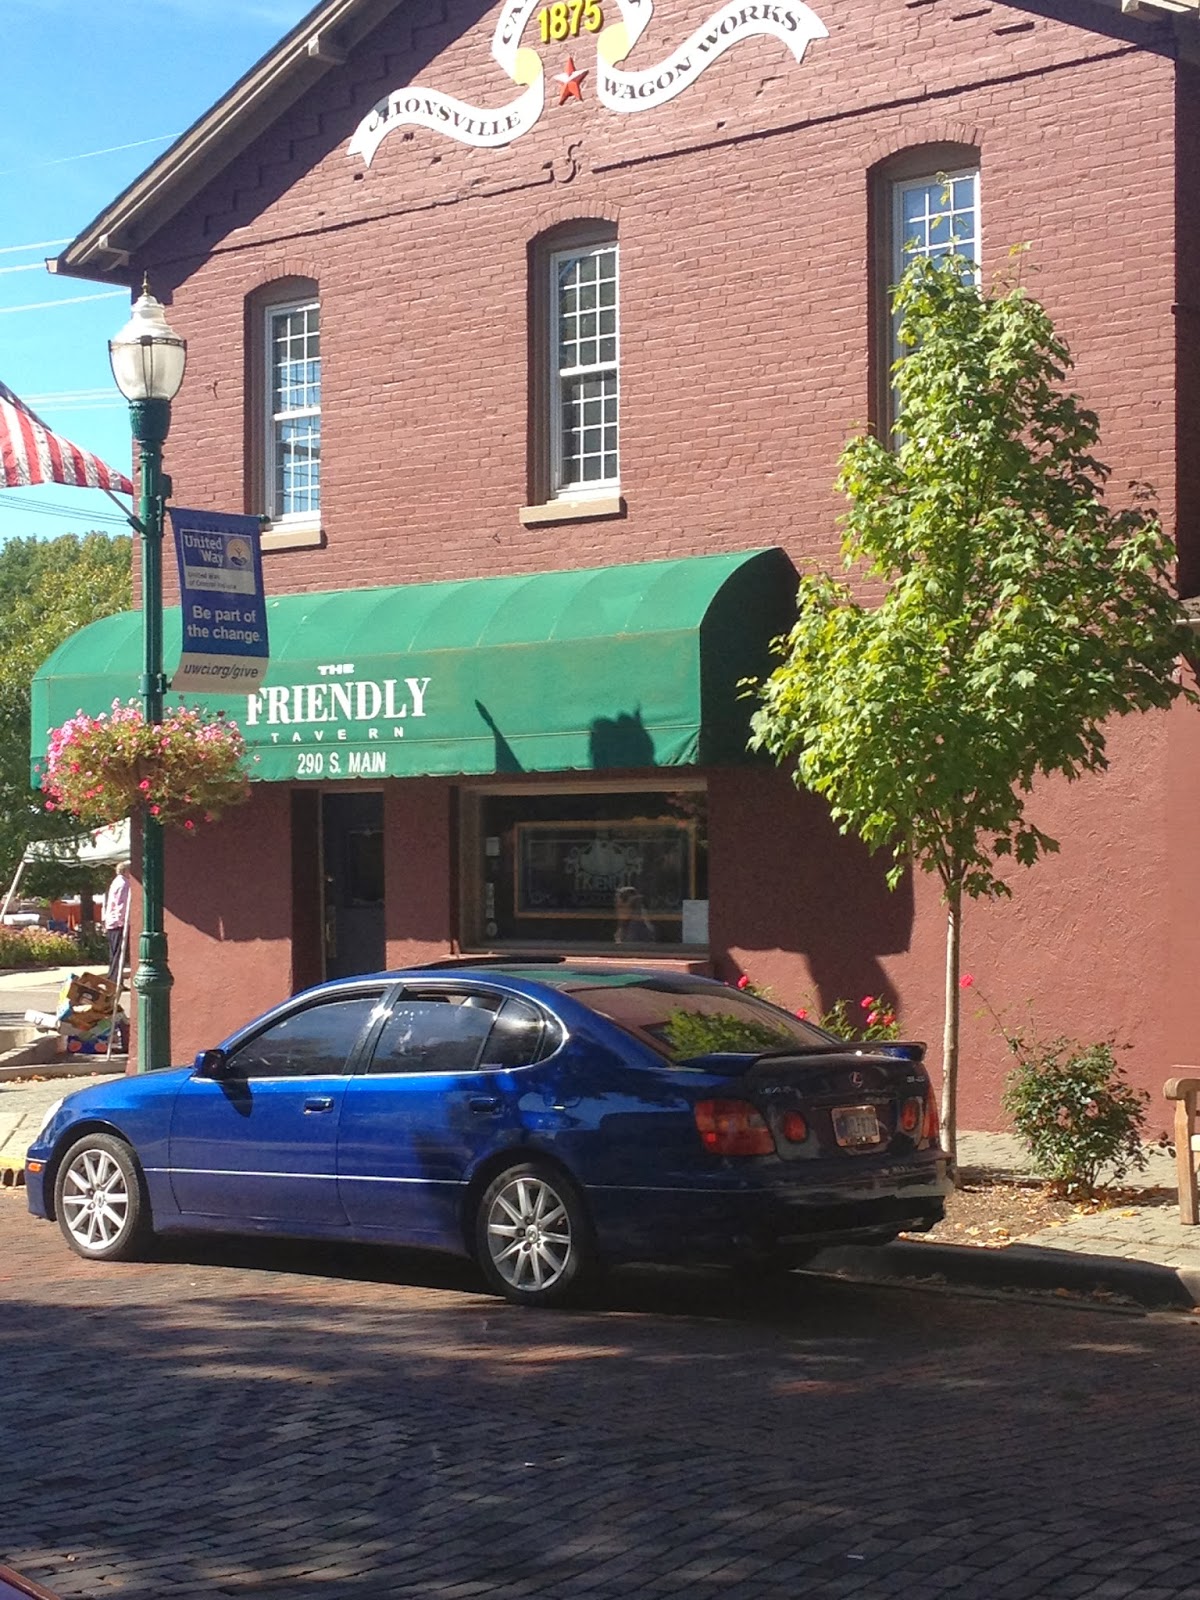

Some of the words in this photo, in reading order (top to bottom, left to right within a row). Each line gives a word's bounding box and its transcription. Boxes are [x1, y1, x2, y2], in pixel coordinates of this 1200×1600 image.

[537, 0, 603, 43] 1875
[605, 57, 692, 99] WAGON
[697, 5, 801, 52] WORKS
[185, 535, 223, 551] United
[200, 550, 224, 567] Way
[192, 605, 212, 620] Be
[215, 608, 241, 623] part
[244, 609, 256, 623] of
[187, 624, 209, 638] the
[184, 663, 259, 680] uwci.org/give
[317, 663, 355, 676] THE
[246, 677, 431, 726] FRIENDLY
[271, 726, 404, 744] TAVERN
[297, 752, 323, 774] 290
[329, 752, 341, 773] S.
[348, 751, 387, 773] MAIN
